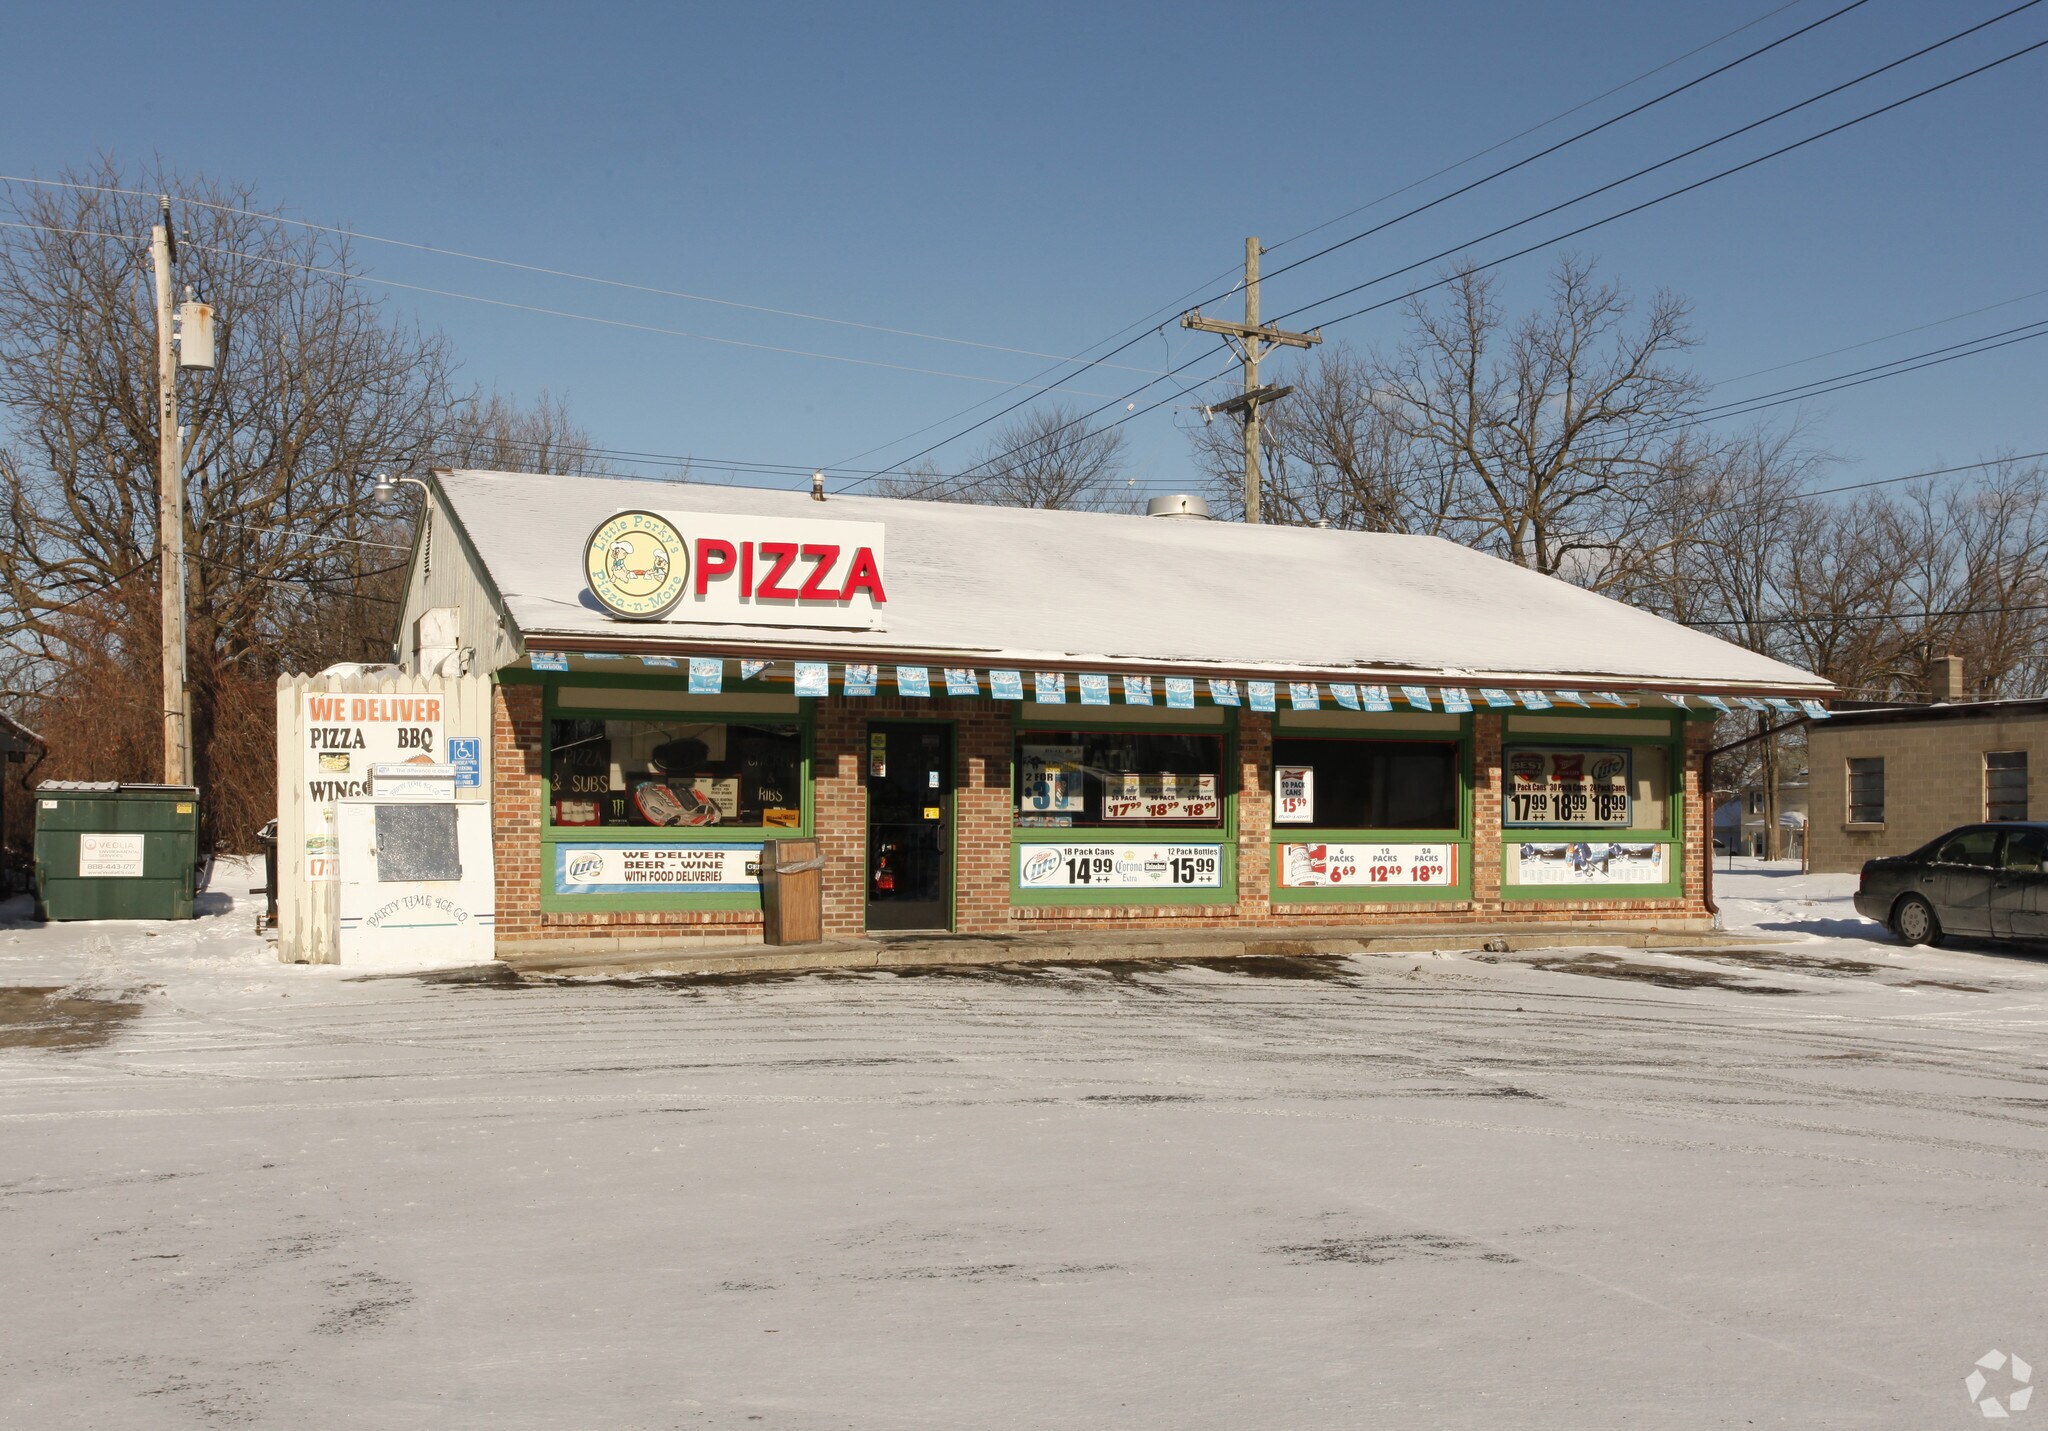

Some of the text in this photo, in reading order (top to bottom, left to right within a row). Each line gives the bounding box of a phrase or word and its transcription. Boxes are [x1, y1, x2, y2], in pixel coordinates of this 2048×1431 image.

[593, 515, 679, 553] Little Porky's
[696, 538, 887, 602] PIZZA
[309, 698, 440, 722] WE DELIVER
[310, 728, 433, 753] PIZZA BBQ
[1513, 761, 1542, 769] BEST
[1598, 762, 1620, 779] Lite
[551, 773, 608, 793] & SUBS
[1026, 773, 1053, 781] 2 FOR
[759, 786, 783, 802] RIBS
[1517, 783, 1531, 791] Pack
[1533, 783, 1547, 791] Cans
[1550, 783, 1557, 791] 30
[1558, 783, 1572, 791] Pack
[573, 860, 602, 876] Lite
[624, 861, 665, 869] BEER
[681, 861, 723, 869] WINE
[1031, 857, 1056, 878] Lite
[1115, 861, 1142, 873] Corona
[624, 871, 722, 881] WITH FOOD DELIVERIES
[1122, 874, 1137, 882] Extra
[366, 899, 399, 928] PARTY
[402, 895, 432, 909] TIME
[435, 897, 454, 915] ICE
